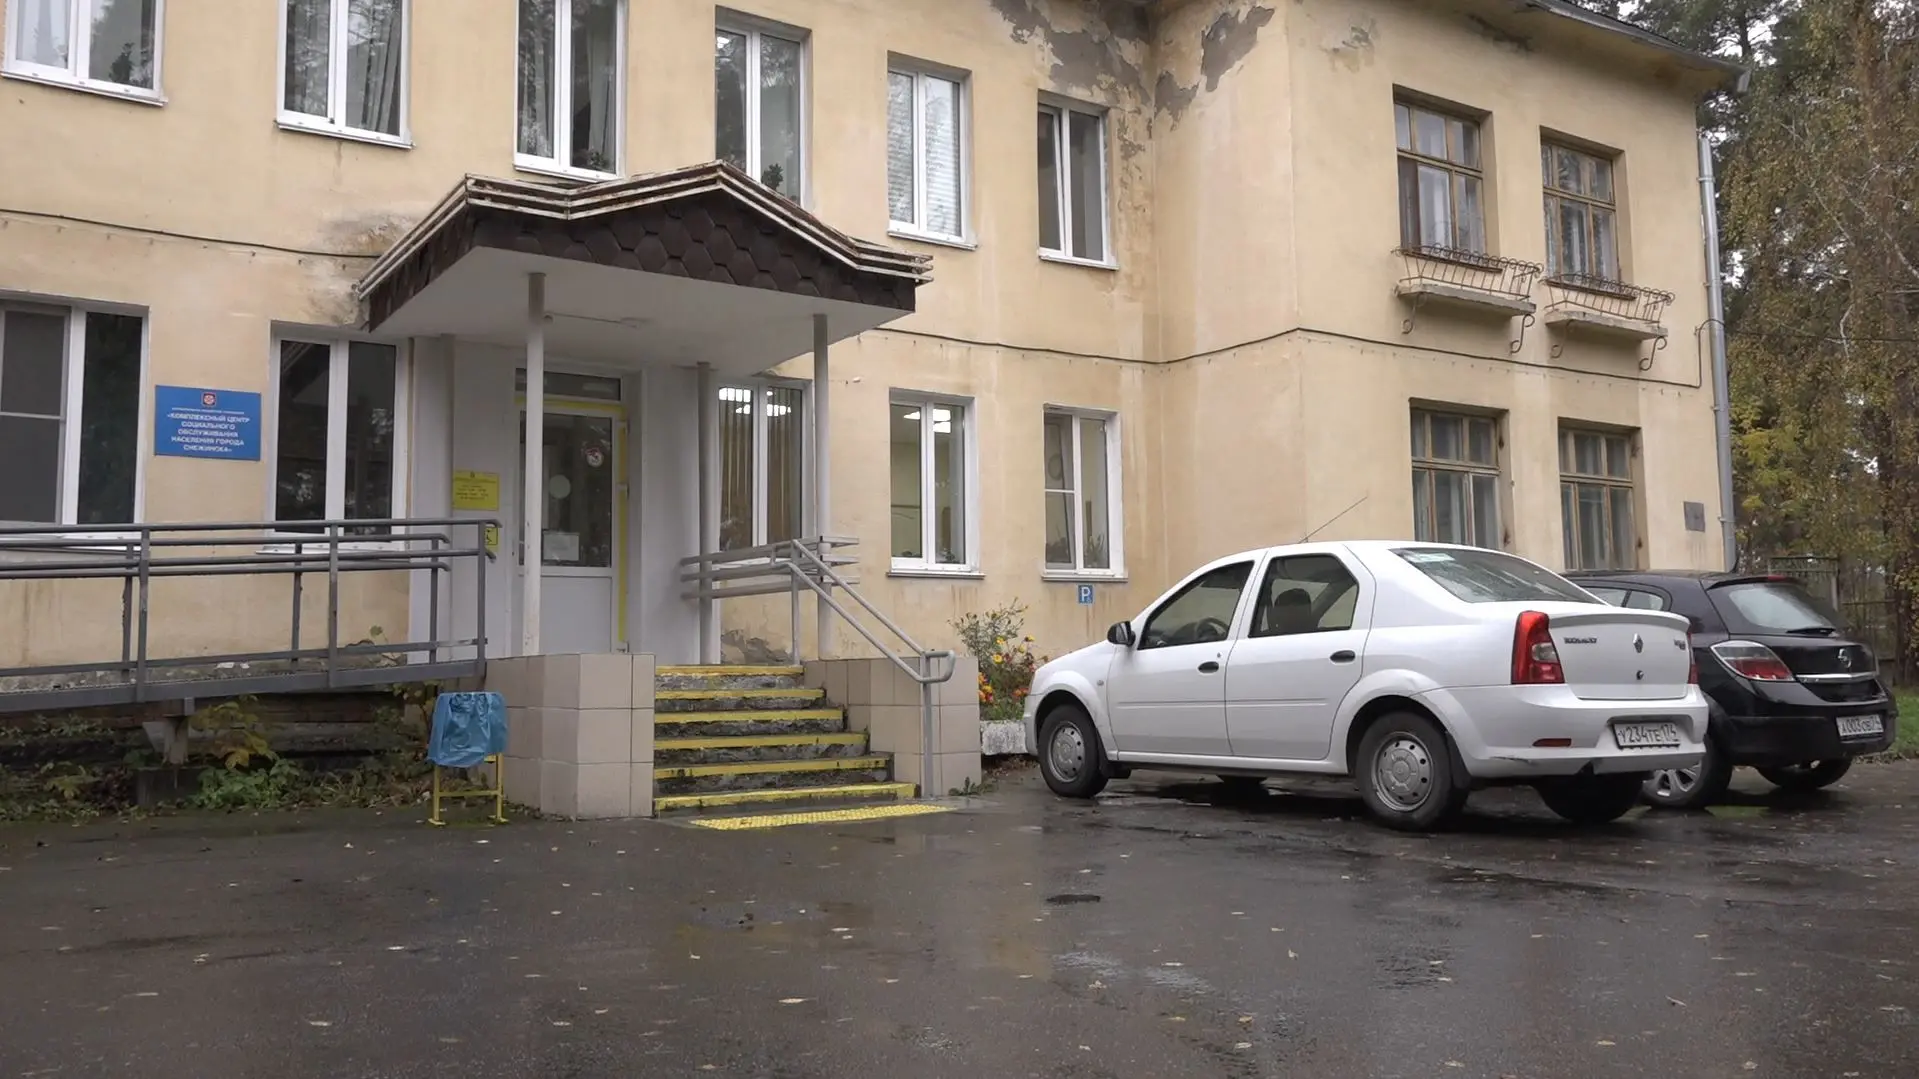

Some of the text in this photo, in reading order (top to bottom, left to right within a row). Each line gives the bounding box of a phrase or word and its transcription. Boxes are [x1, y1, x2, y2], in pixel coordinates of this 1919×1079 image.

[227, 415, 250, 423] ЦЕНТР
[181, 421, 236, 430] СОЦИАЛЬНОГО
[178, 428, 239, 438] ОБСЛУЖИВАНИЯ
[171, 436, 245, 446] НАСЕЛЕНИЯ ГОРОДА
[1081, 586, 1091, 602] P
